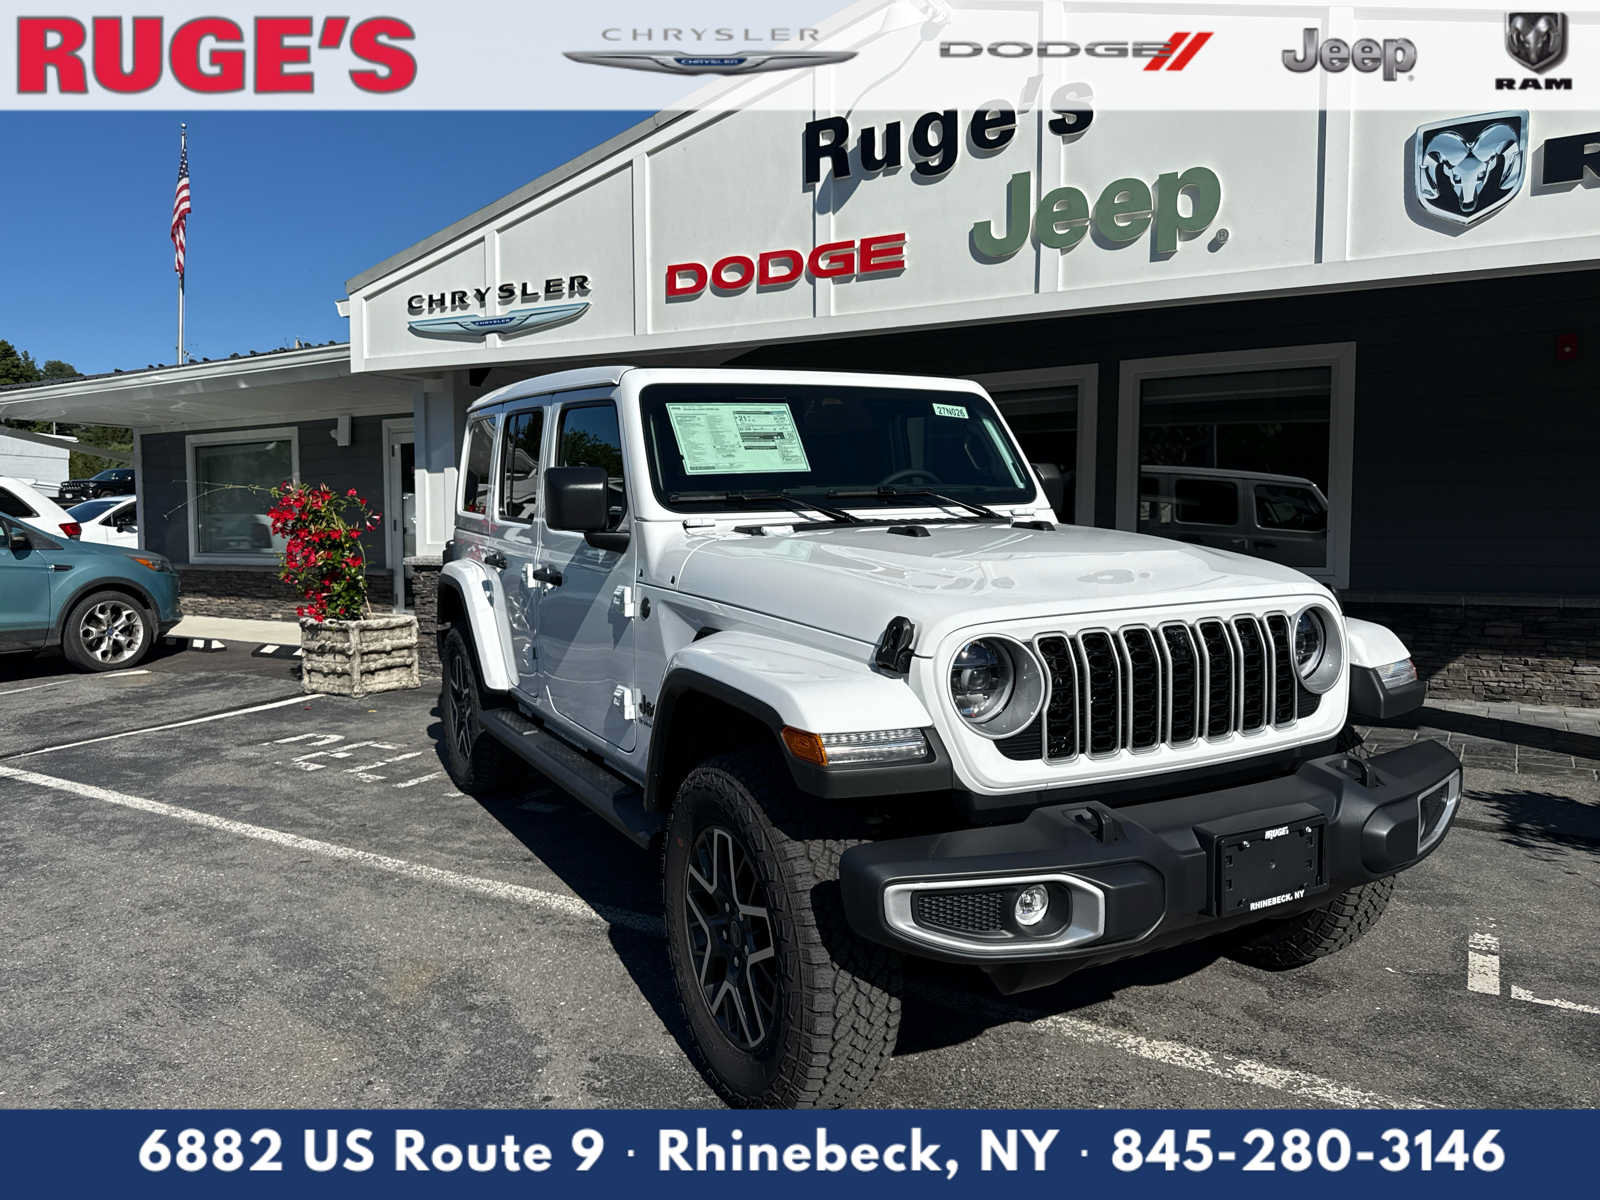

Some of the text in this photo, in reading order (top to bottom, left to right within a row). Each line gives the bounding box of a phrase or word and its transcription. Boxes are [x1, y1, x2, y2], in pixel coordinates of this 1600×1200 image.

[805, 74, 1095, 184] Ruge's
[973, 166, 1222, 253] Jeep
[407, 274, 591, 310] CHRYSLER
[666, 232, 906, 297] DODGE
[1294, 889, 1305, 900] NY
